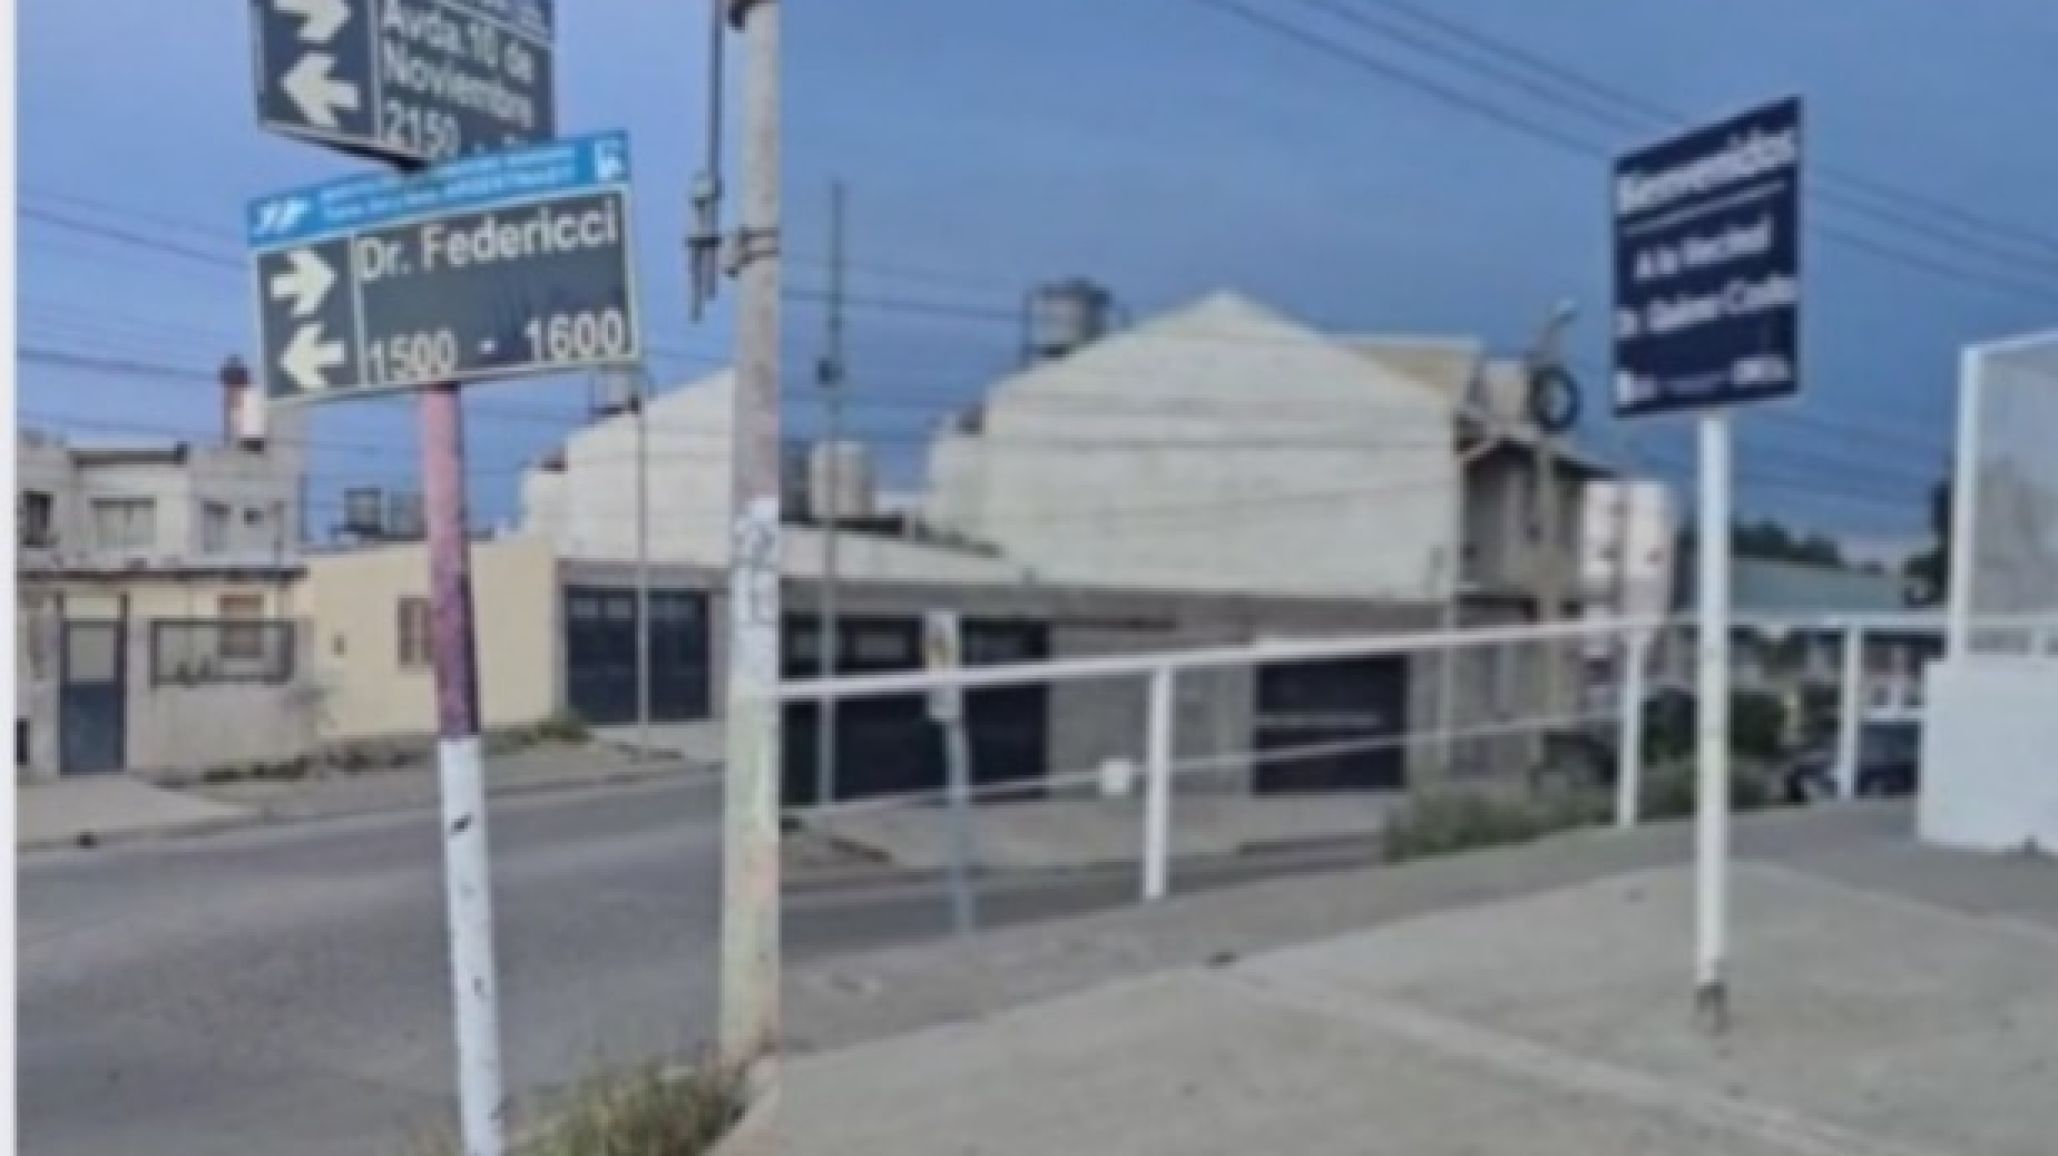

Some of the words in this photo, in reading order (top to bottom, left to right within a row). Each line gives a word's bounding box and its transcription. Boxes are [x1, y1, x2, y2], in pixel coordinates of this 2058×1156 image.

[359, 236, 412, 281] Dr.
[420, 196, 616, 271] Federicci
[367, 330, 457, 384] 1500
[525, 307, 622, 361] 1600
